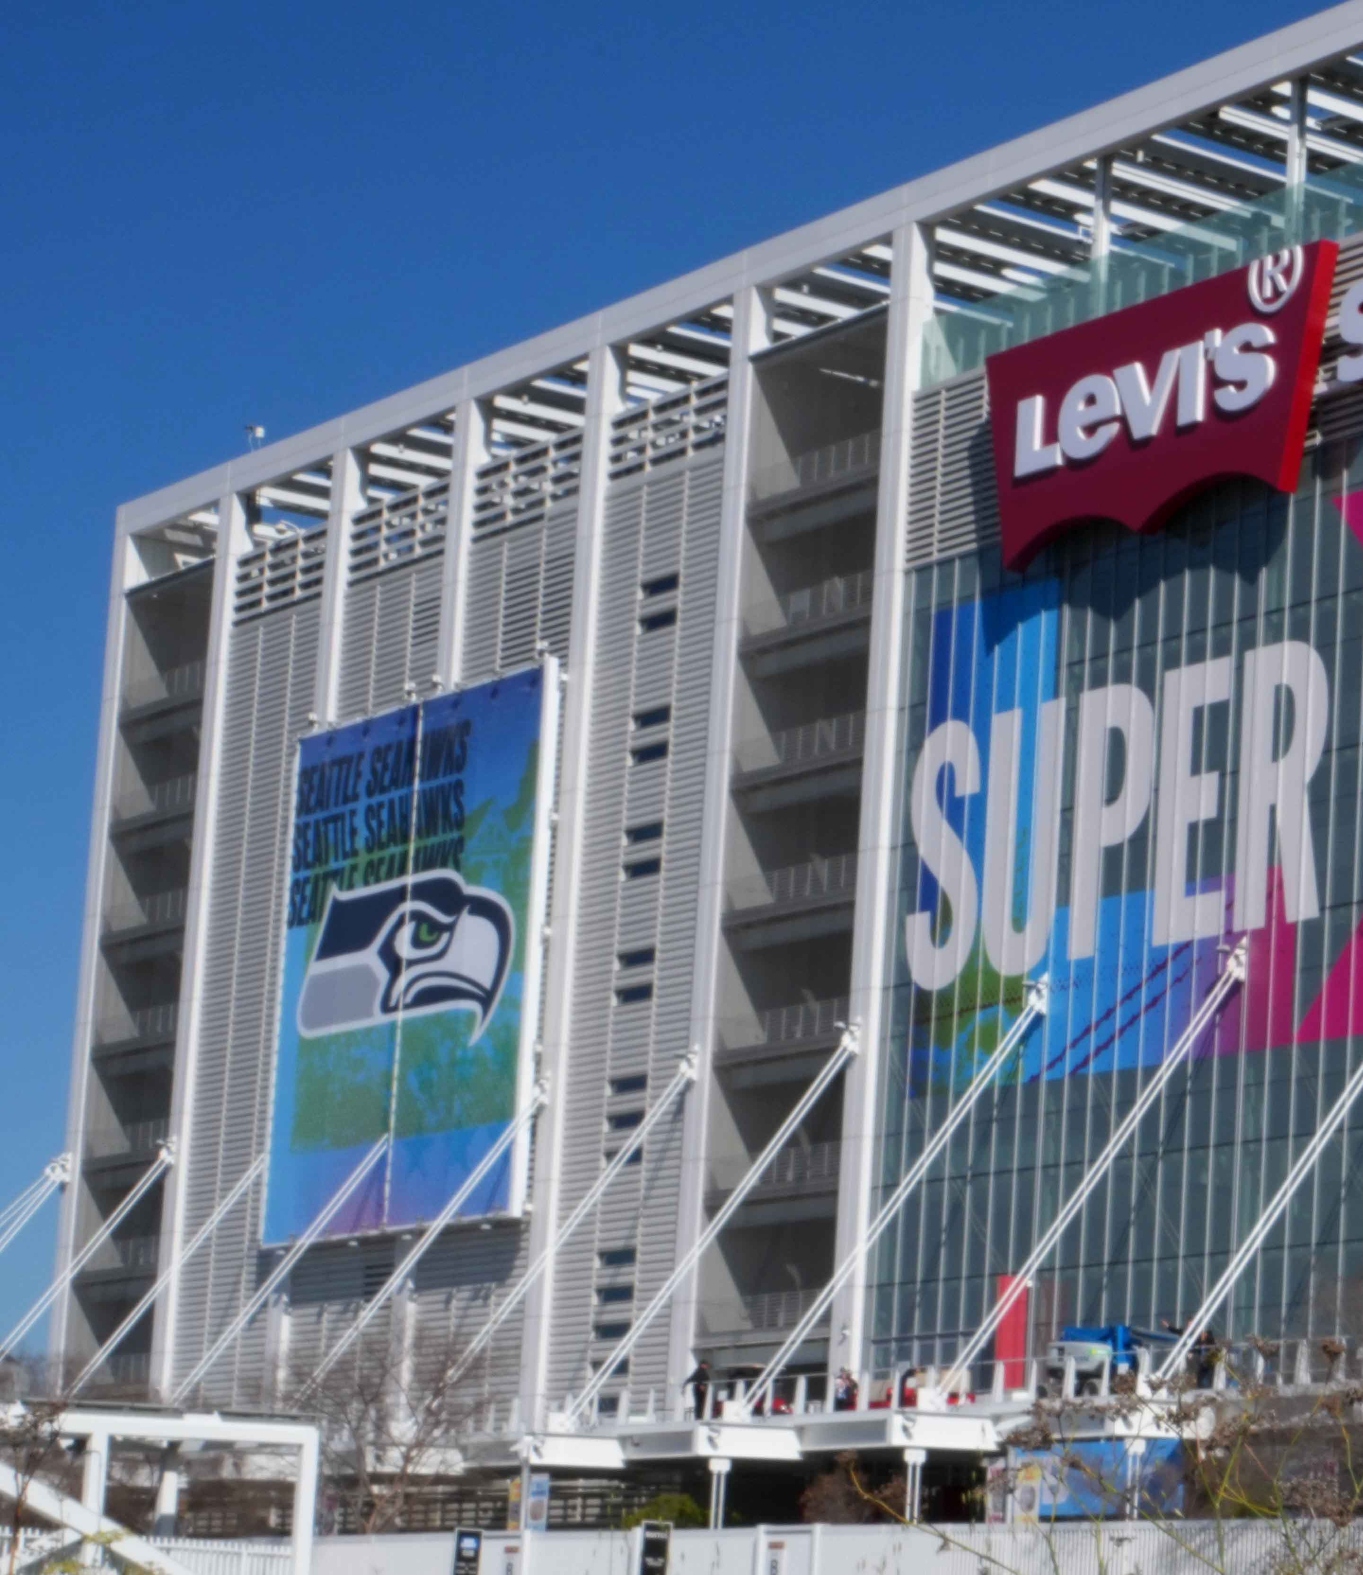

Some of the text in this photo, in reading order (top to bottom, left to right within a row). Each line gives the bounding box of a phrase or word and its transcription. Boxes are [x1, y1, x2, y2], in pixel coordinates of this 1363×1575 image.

[292, 808, 359, 874] SEATTLE
[364, 778, 466, 854] SEAHAWKS
[904, 639, 1329, 991] SUPER
